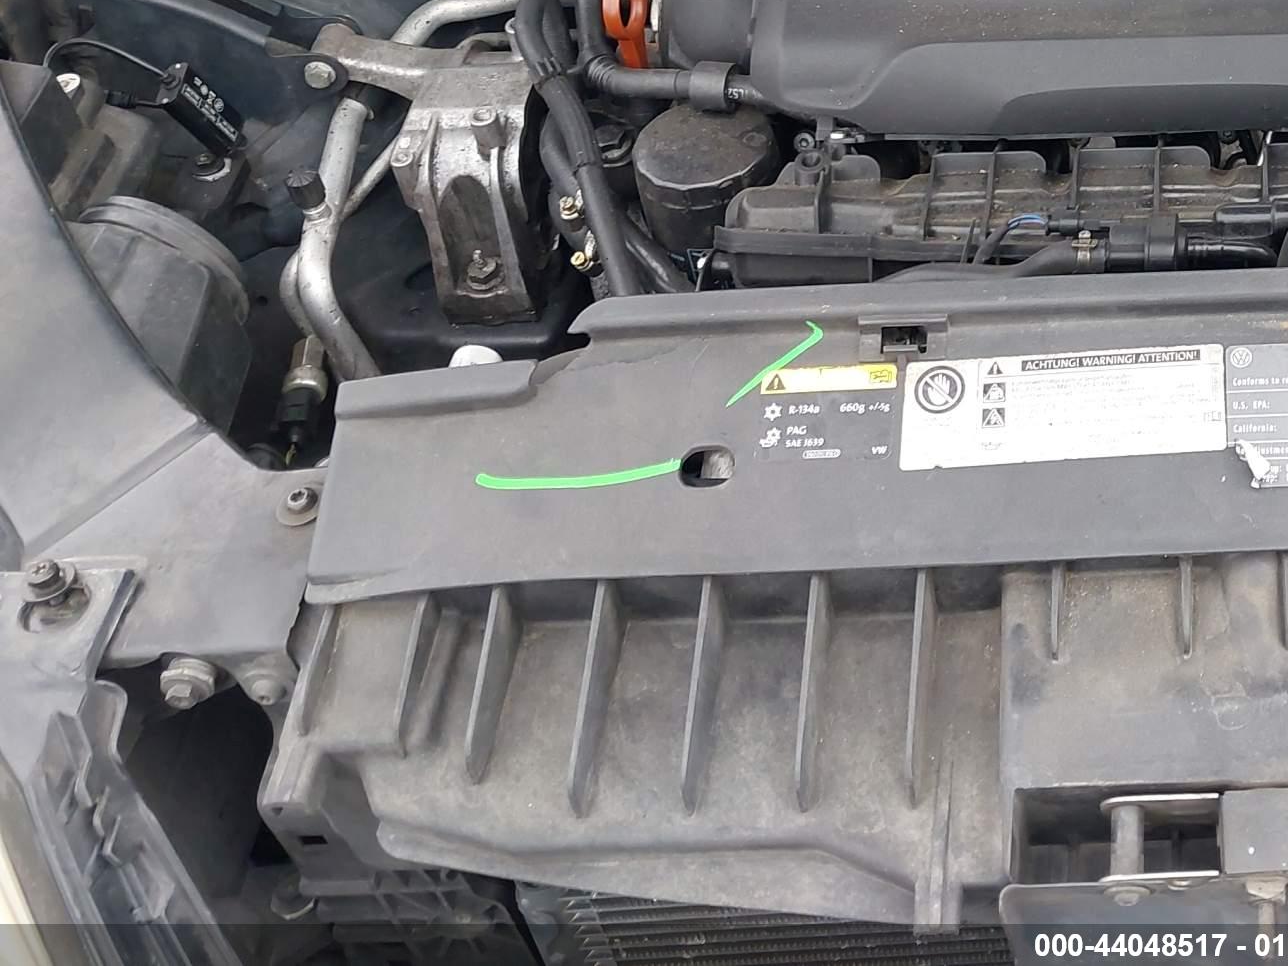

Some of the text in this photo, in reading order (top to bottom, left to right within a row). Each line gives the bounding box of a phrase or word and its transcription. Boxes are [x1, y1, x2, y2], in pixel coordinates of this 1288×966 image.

[1024, 350, 1198, 372] ACHTUNG! WARNING! ATTENTION!
[1232, 377, 1269, 387] Conforms
[788, 404, 821, 415] R-134a
[839, 402, 866, 415] 660g
[786, 425, 808, 435] PAG
[785, 439, 802, 448] SAE
